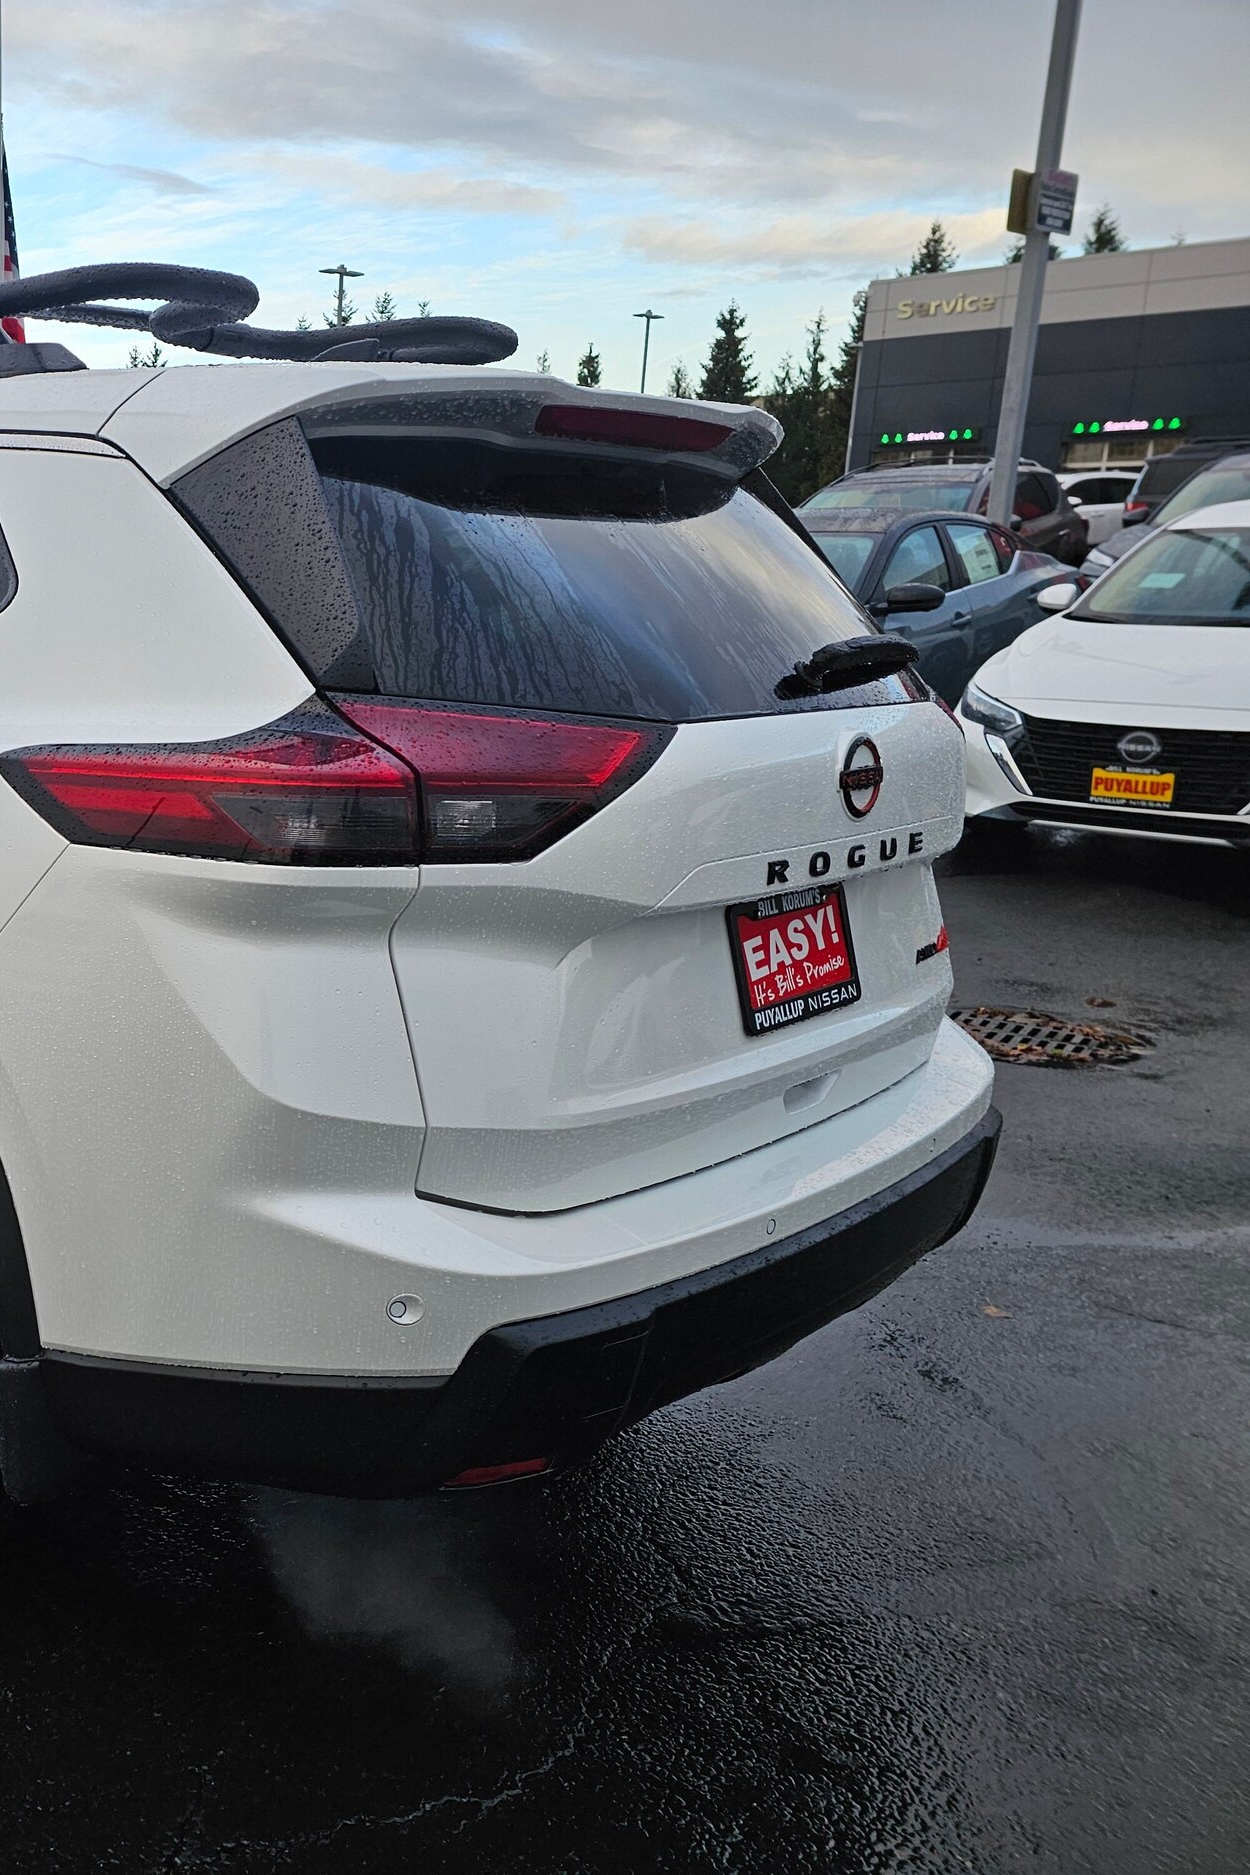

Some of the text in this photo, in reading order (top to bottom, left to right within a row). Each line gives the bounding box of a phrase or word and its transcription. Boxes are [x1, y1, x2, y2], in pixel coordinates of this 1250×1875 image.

[897, 292, 997, 319] Service
[1093, 776, 1172, 796] PUYALLUP
[766, 831, 924, 886] ROGUE
[758, 888, 821, 917] BILL KORUM'S
[743, 905, 839, 982] EASY!
[754, 954, 845, 1008] It's Bill's Promise
[755, 983, 858, 1030] PUYALLUP NISSAN
